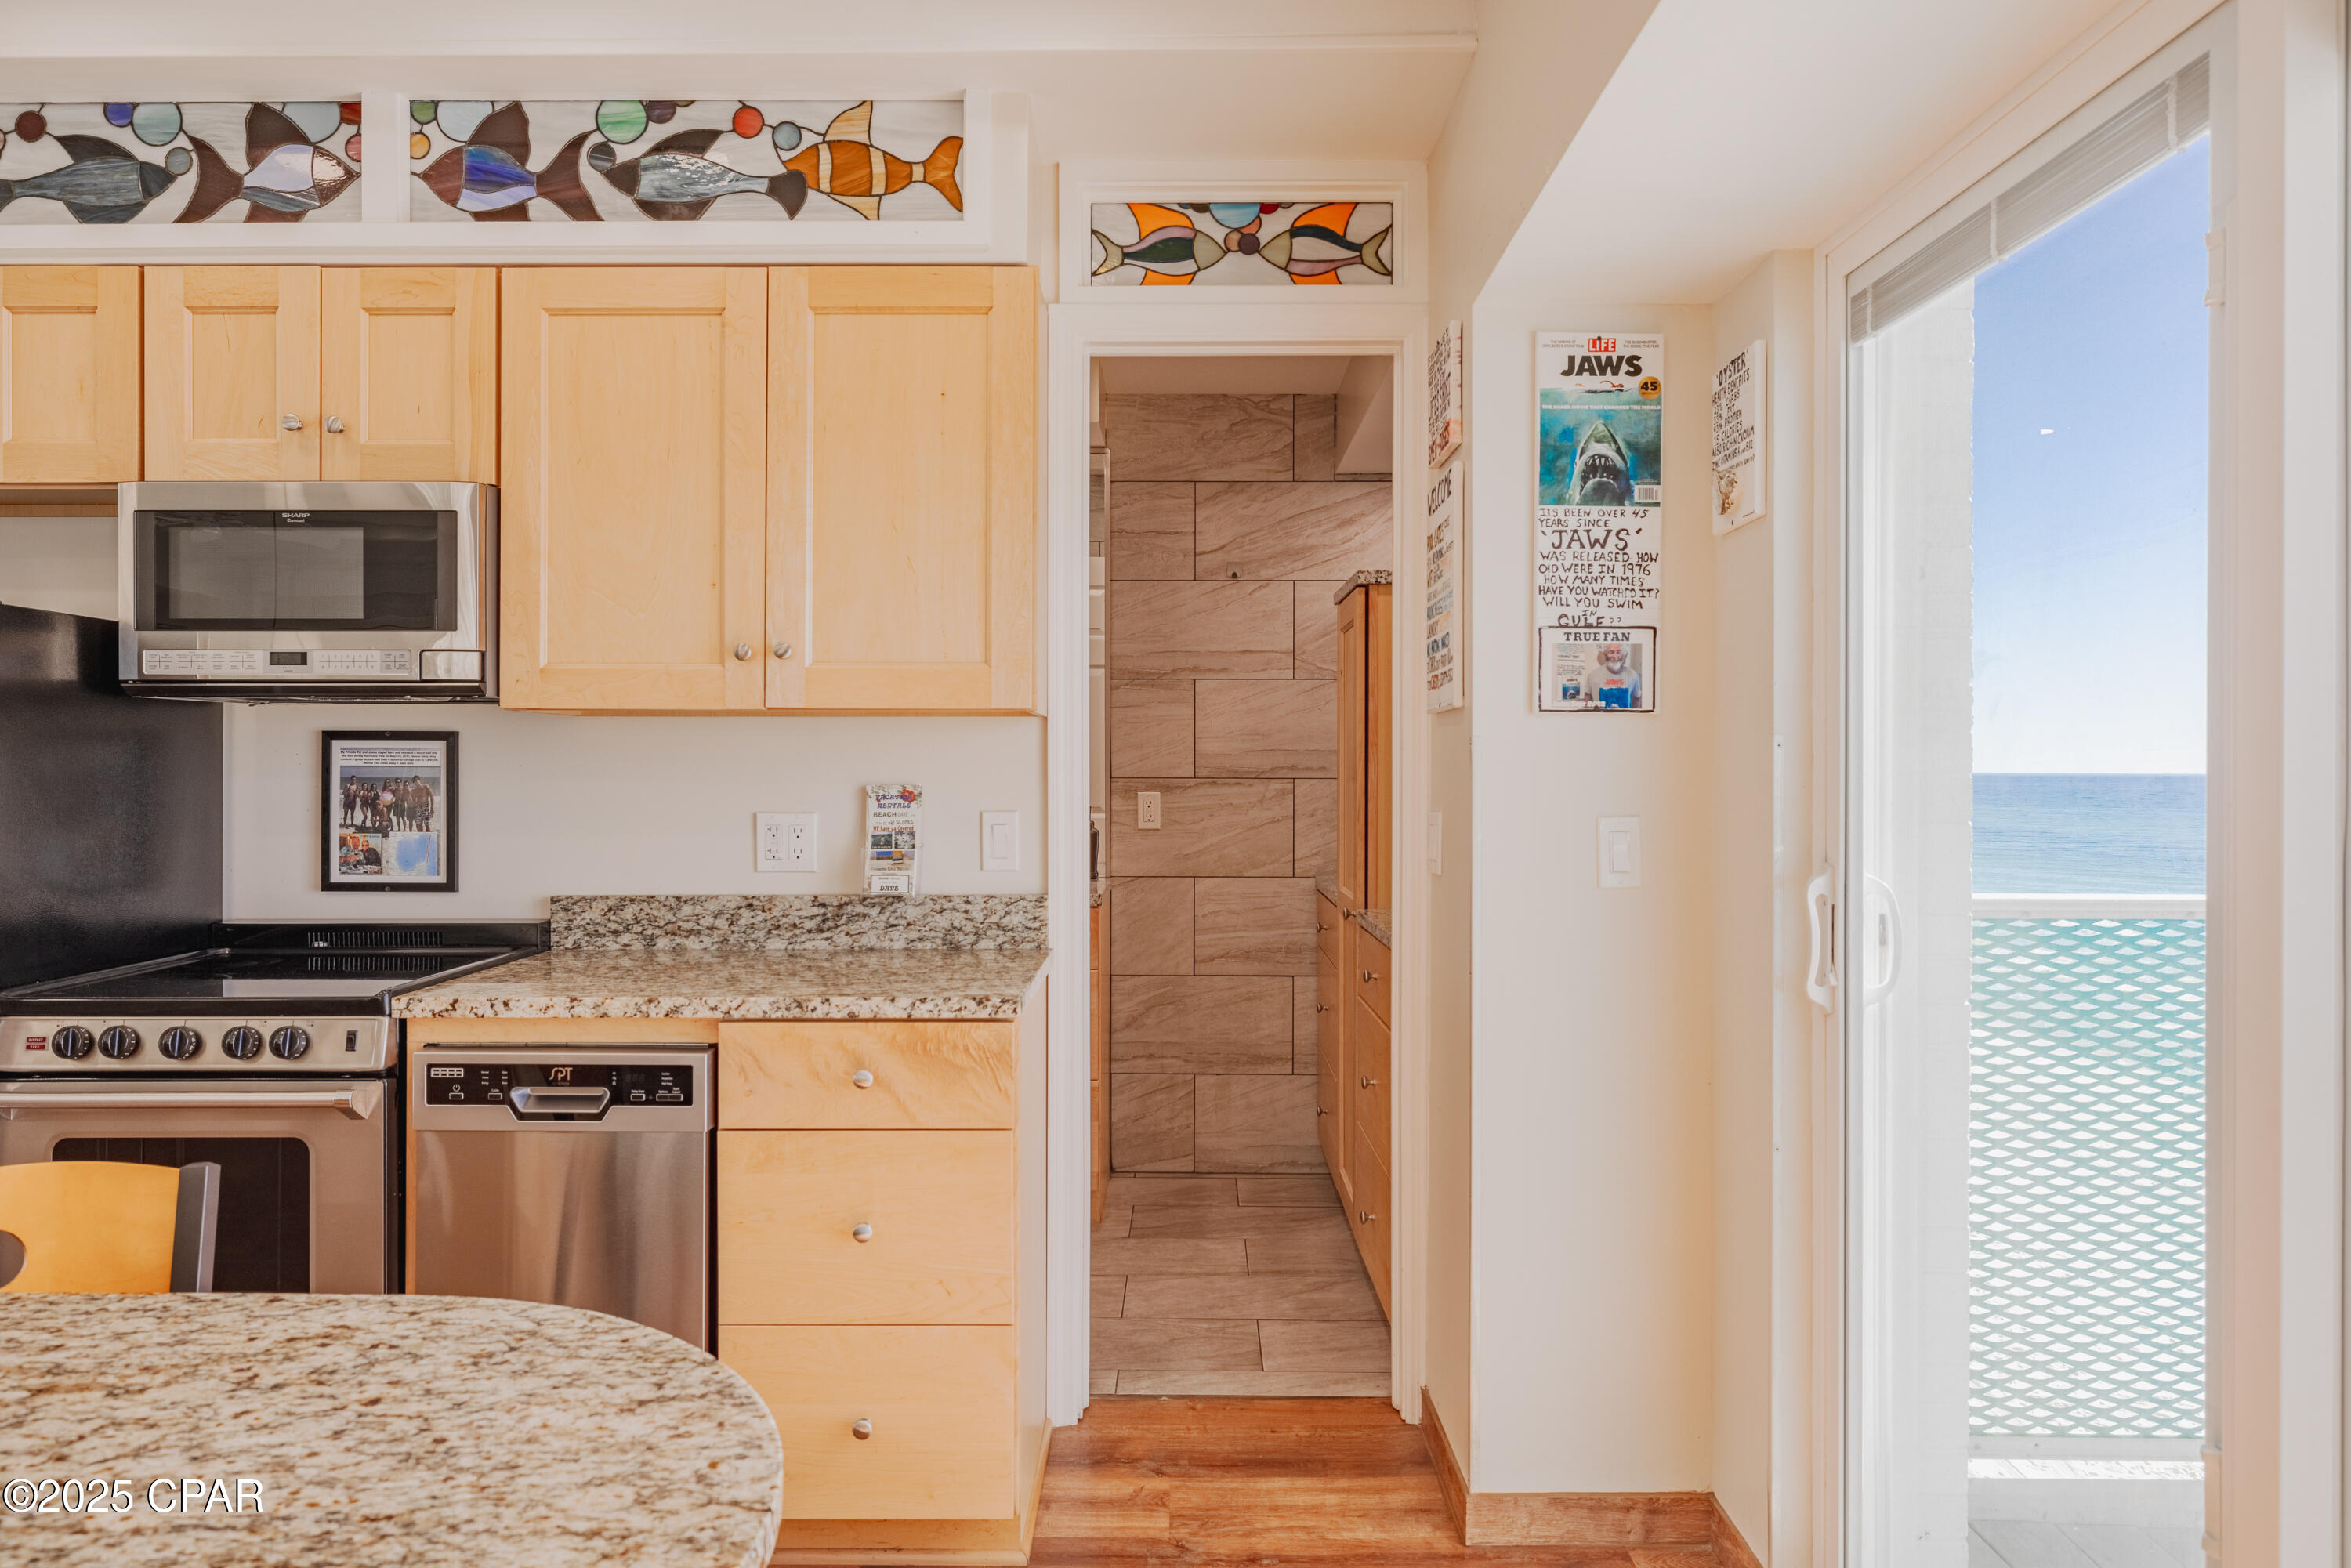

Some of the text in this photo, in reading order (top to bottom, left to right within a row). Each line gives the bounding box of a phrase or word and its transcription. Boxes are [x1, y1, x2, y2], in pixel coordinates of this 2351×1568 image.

[1589, 339, 1615, 351] LIFE
[1560, 355, 1643, 377] JAWS
[1641, 381, 1658, 391] 45
[1564, 509, 1591, 517] BEEN
[1598, 509, 1625, 518] OVER
[1632, 509, 1649, 519] 45
[1538, 518, 1611, 527] YEARS SINCE
[1539, 551, 1567, 562] WAS
[1636, 552, 1659, 563] HOW
[1561, 563, 1593, 574] WERE
[1599, 564, 1615, 574] IN
[1622, 563, 1651, 576] 1976
[1544, 574, 1645, 588] HOW MANY TIMES
[1538, 587, 1563, 596] HAVE
[1568, 587, 1588, 596] YOU
[1543, 596, 1643, 610] WILL YOU SWIM
[1563, 632, 1631, 641] TRUE FAN
